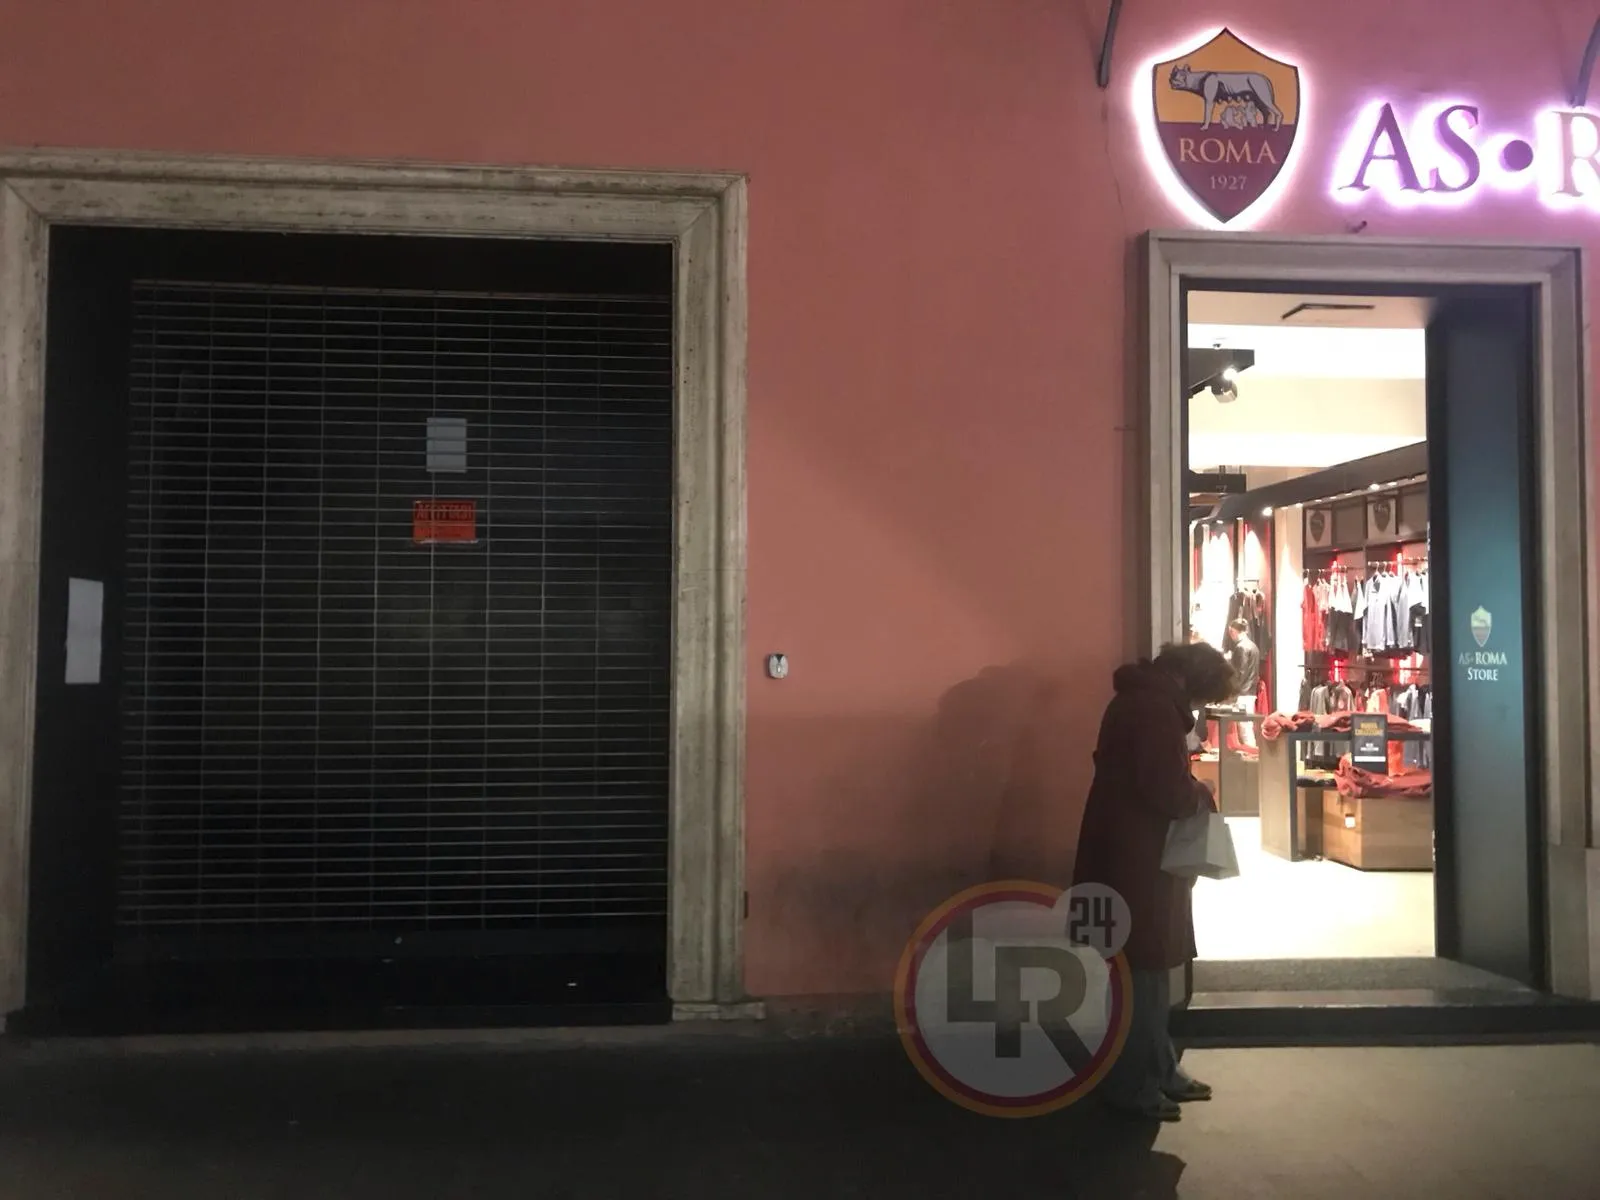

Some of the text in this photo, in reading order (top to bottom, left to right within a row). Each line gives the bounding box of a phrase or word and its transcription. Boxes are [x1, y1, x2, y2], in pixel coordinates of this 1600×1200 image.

[1179, 137, 1279, 164] ROMA
[1210, 174, 1248, 190] 1927
[1475, 651, 1507, 665] ROMA
[1467, 667, 1499, 681] STORE
